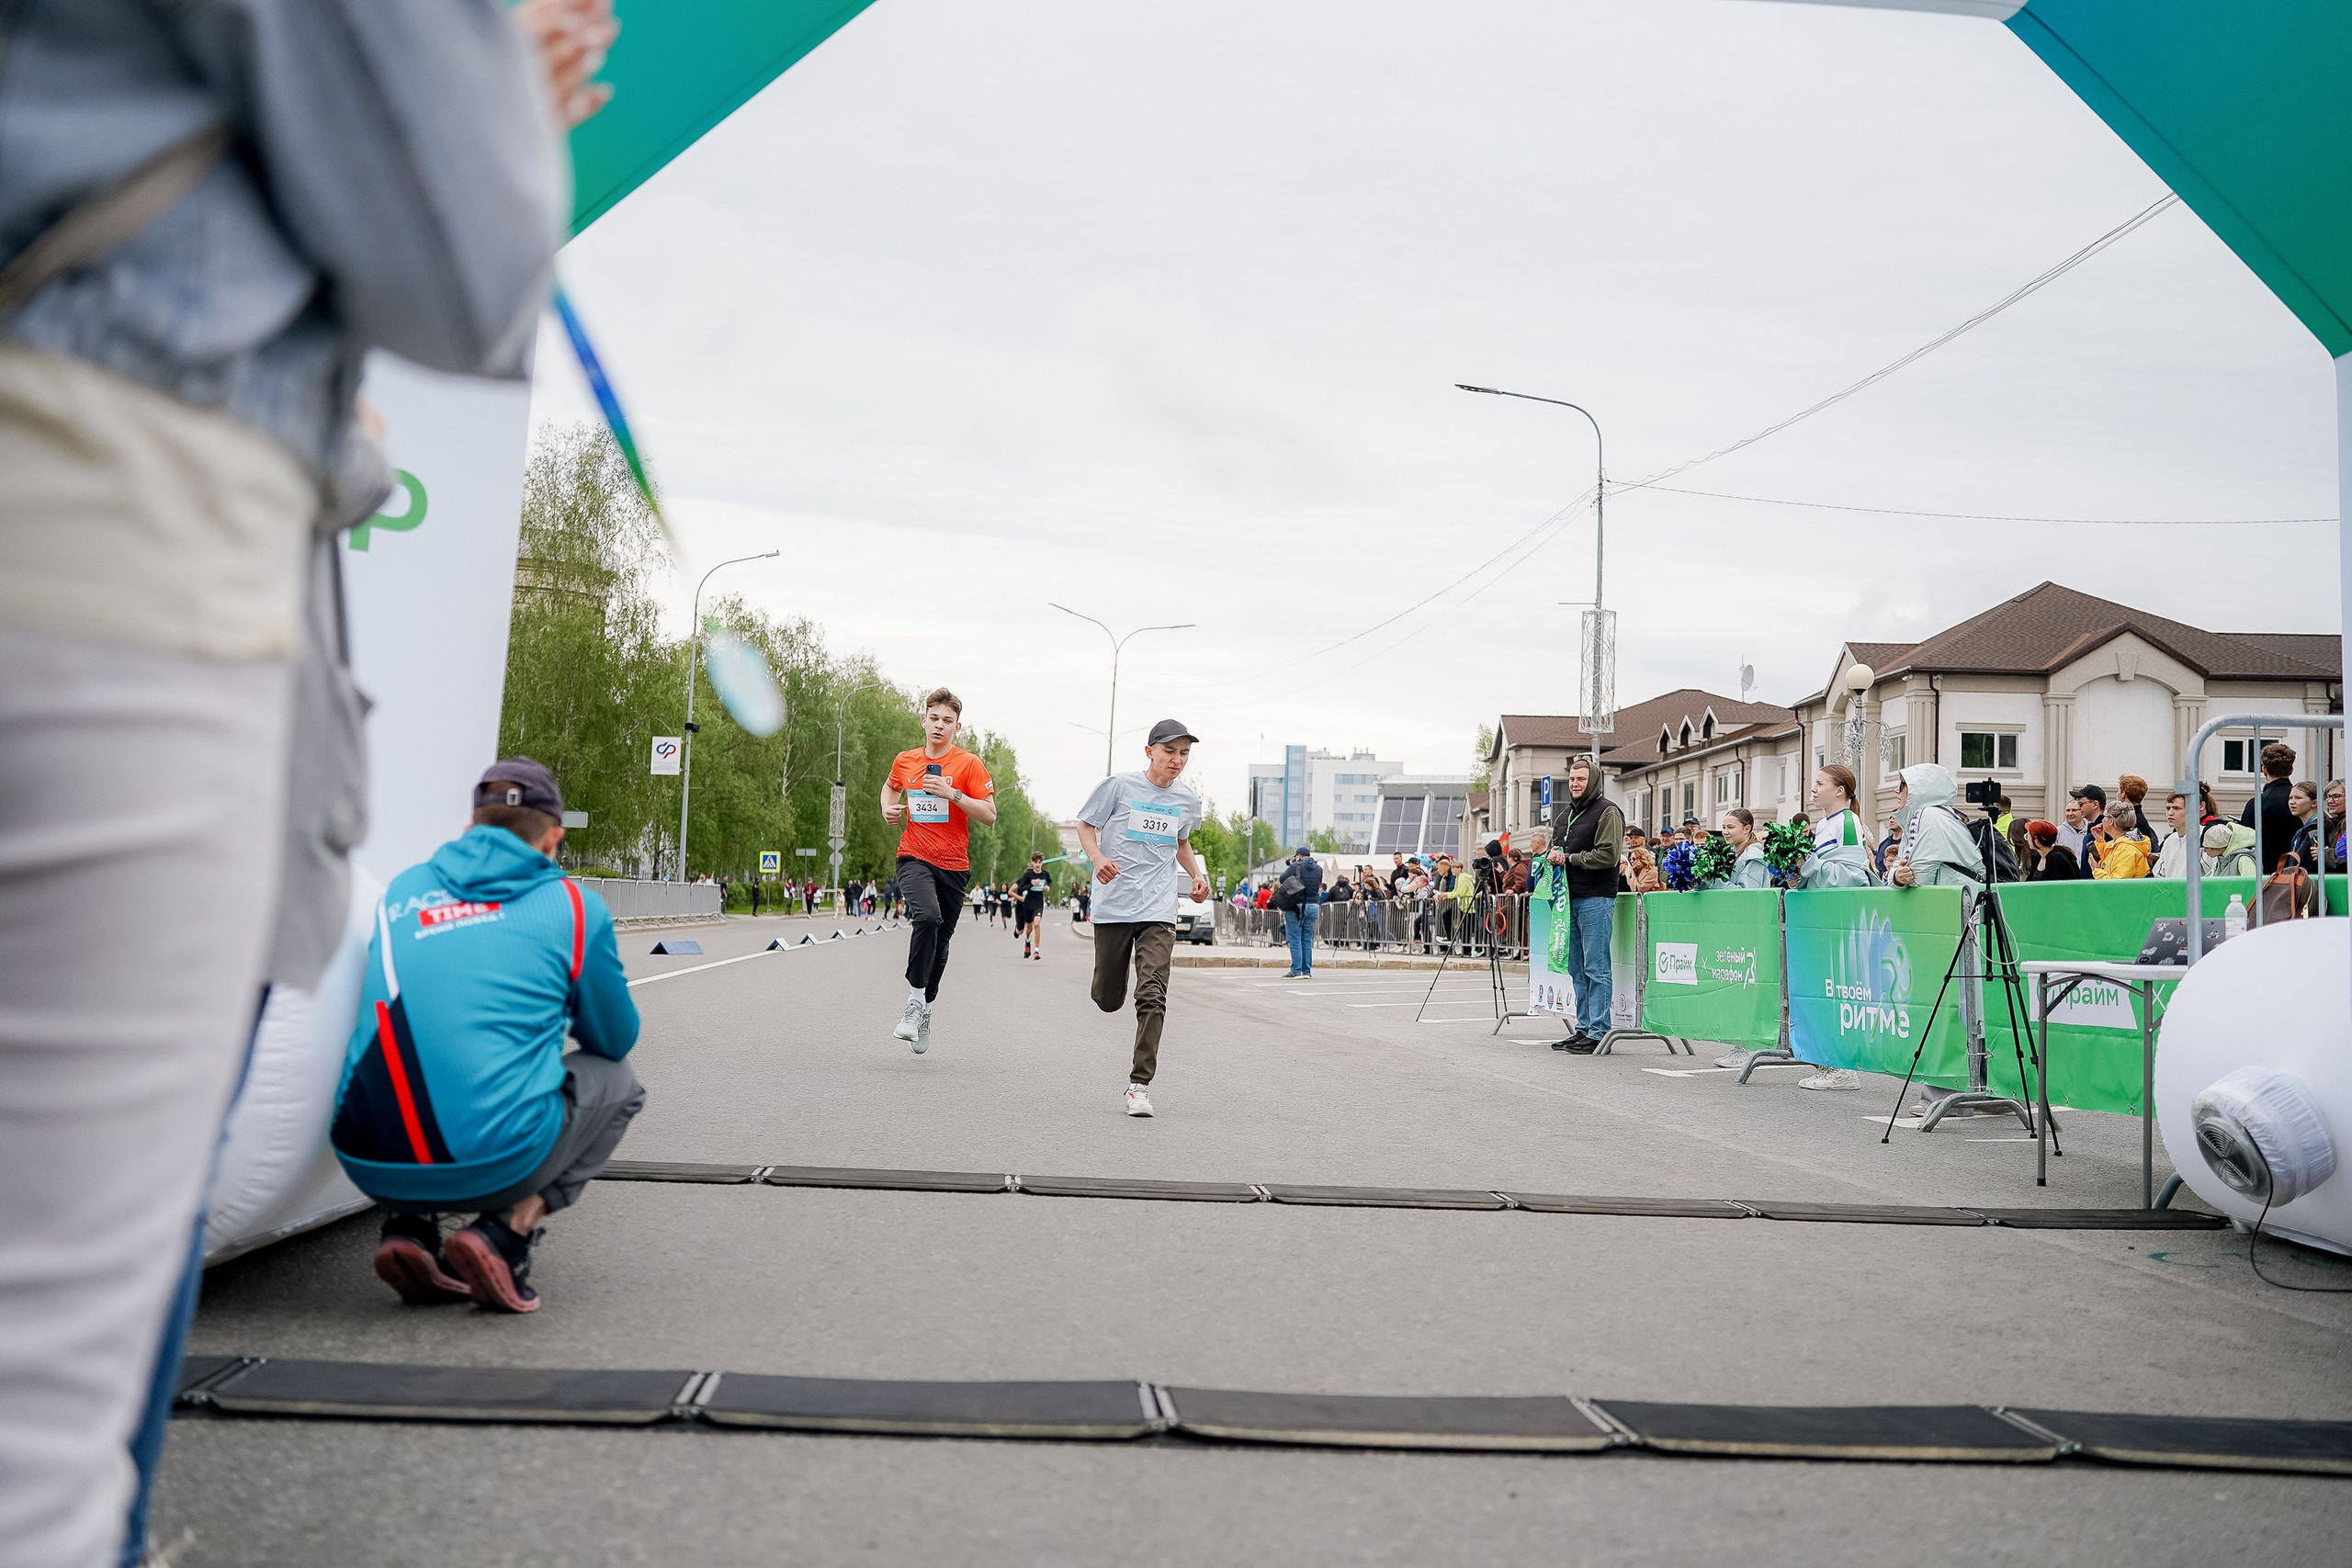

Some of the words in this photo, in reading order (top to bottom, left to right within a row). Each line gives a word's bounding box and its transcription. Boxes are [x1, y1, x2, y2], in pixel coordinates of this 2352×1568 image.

[1544, 779, 1549, 803] P
[916, 803, 938, 812] 3434
[1142, 819, 1168, 832] 3319
[1669, 954, 1692, 974] Прайм
[1715, 947, 1746, 964] зелёный
[1712, 964, 1743, 985] марафон
[1825, 978, 1834, 998] В
[1836, 980, 1871, 1001] твоём
[1839, 1002, 1910, 1039] ритме
